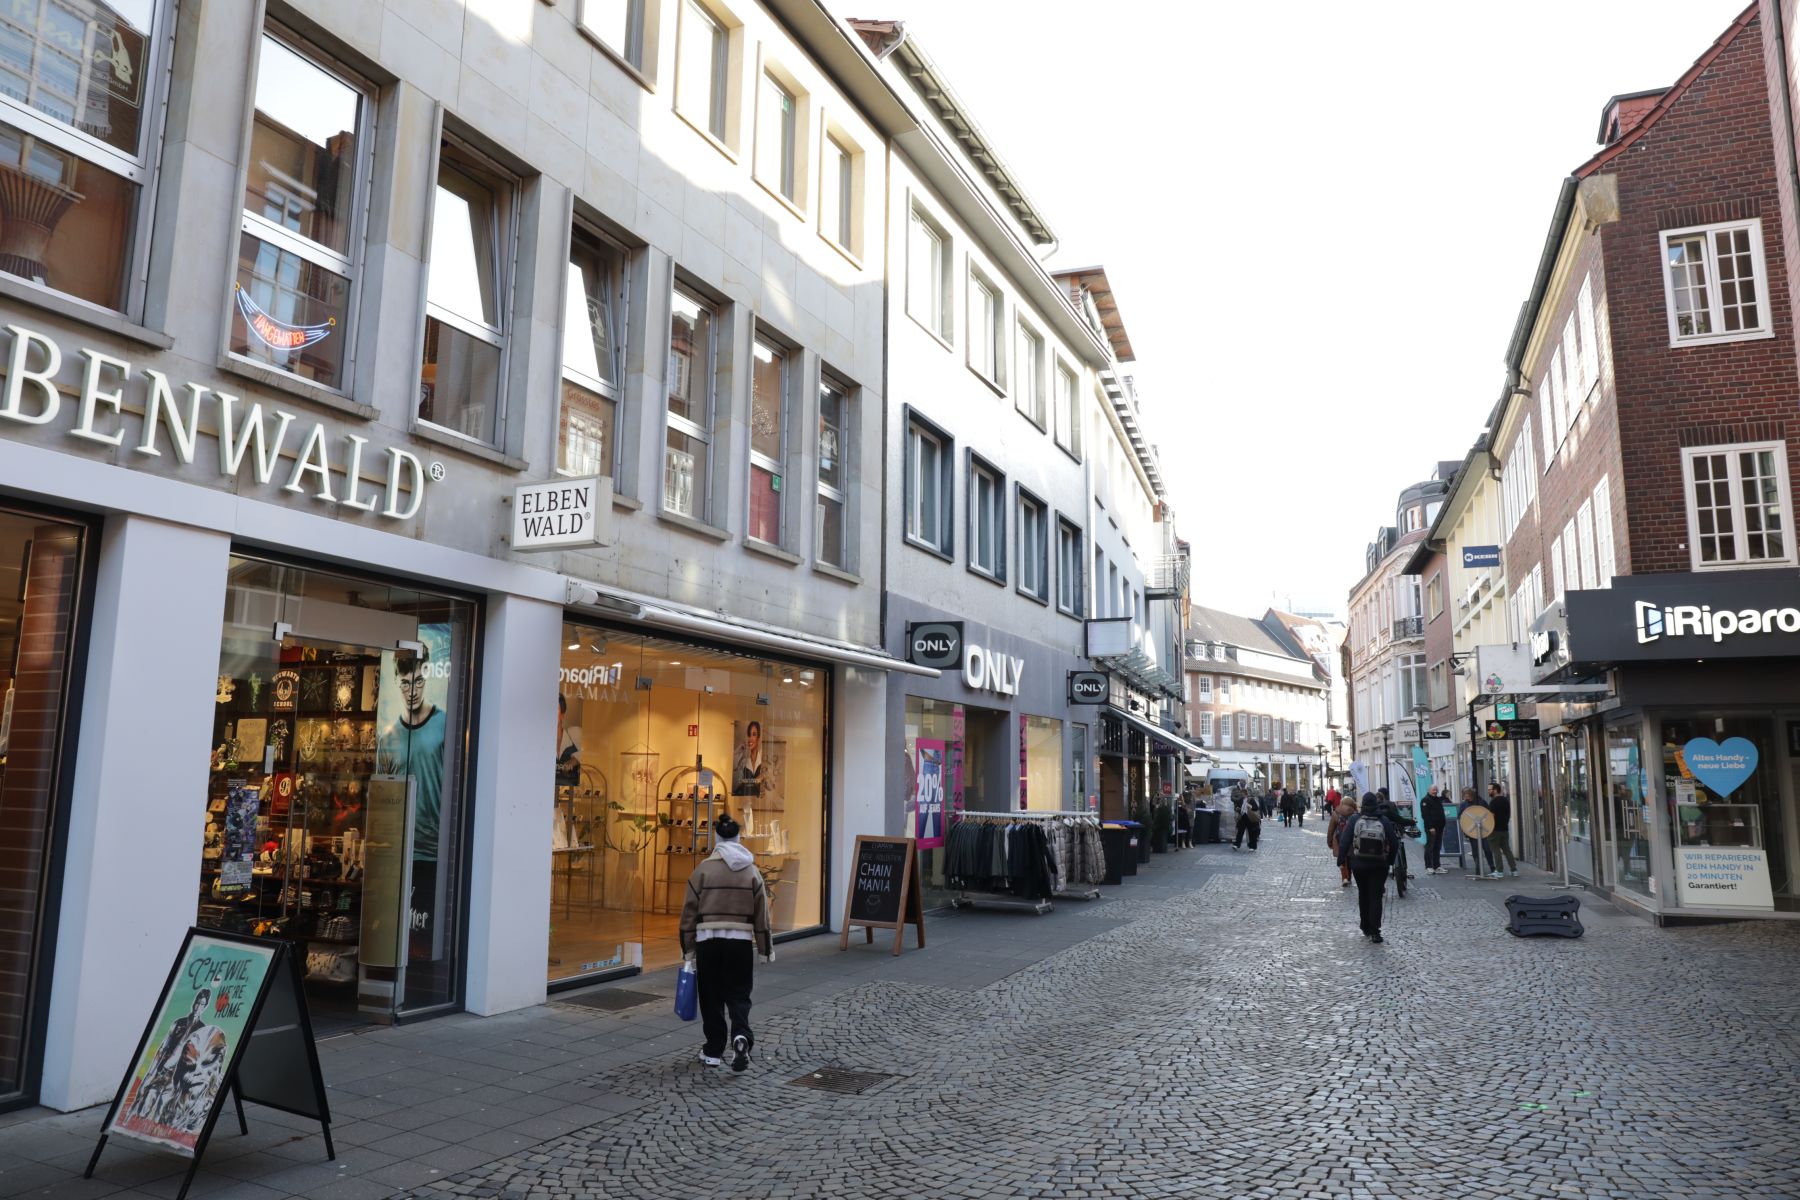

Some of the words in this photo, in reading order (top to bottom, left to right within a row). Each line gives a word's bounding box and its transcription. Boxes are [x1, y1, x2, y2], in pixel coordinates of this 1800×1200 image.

[521, 487, 589, 514] ELBEN
[1665, 605, 1800, 642] iRiparo
[914, 640, 957, 652] ONLY
[962, 644, 1025, 696] ONLY
[1074, 683, 1105, 694] ONLY
[1715, 754, 1744, 763] Handy
[916, 773, 944, 802] 20%
[860, 863, 892, 878] CHAIN
[1709, 863, 1740, 871] HANDY
[858, 878, 890, 892] MANIA
[1688, 882, 1738, 890] Garantiert!
[188, 957, 252, 990] CHEWIE,
